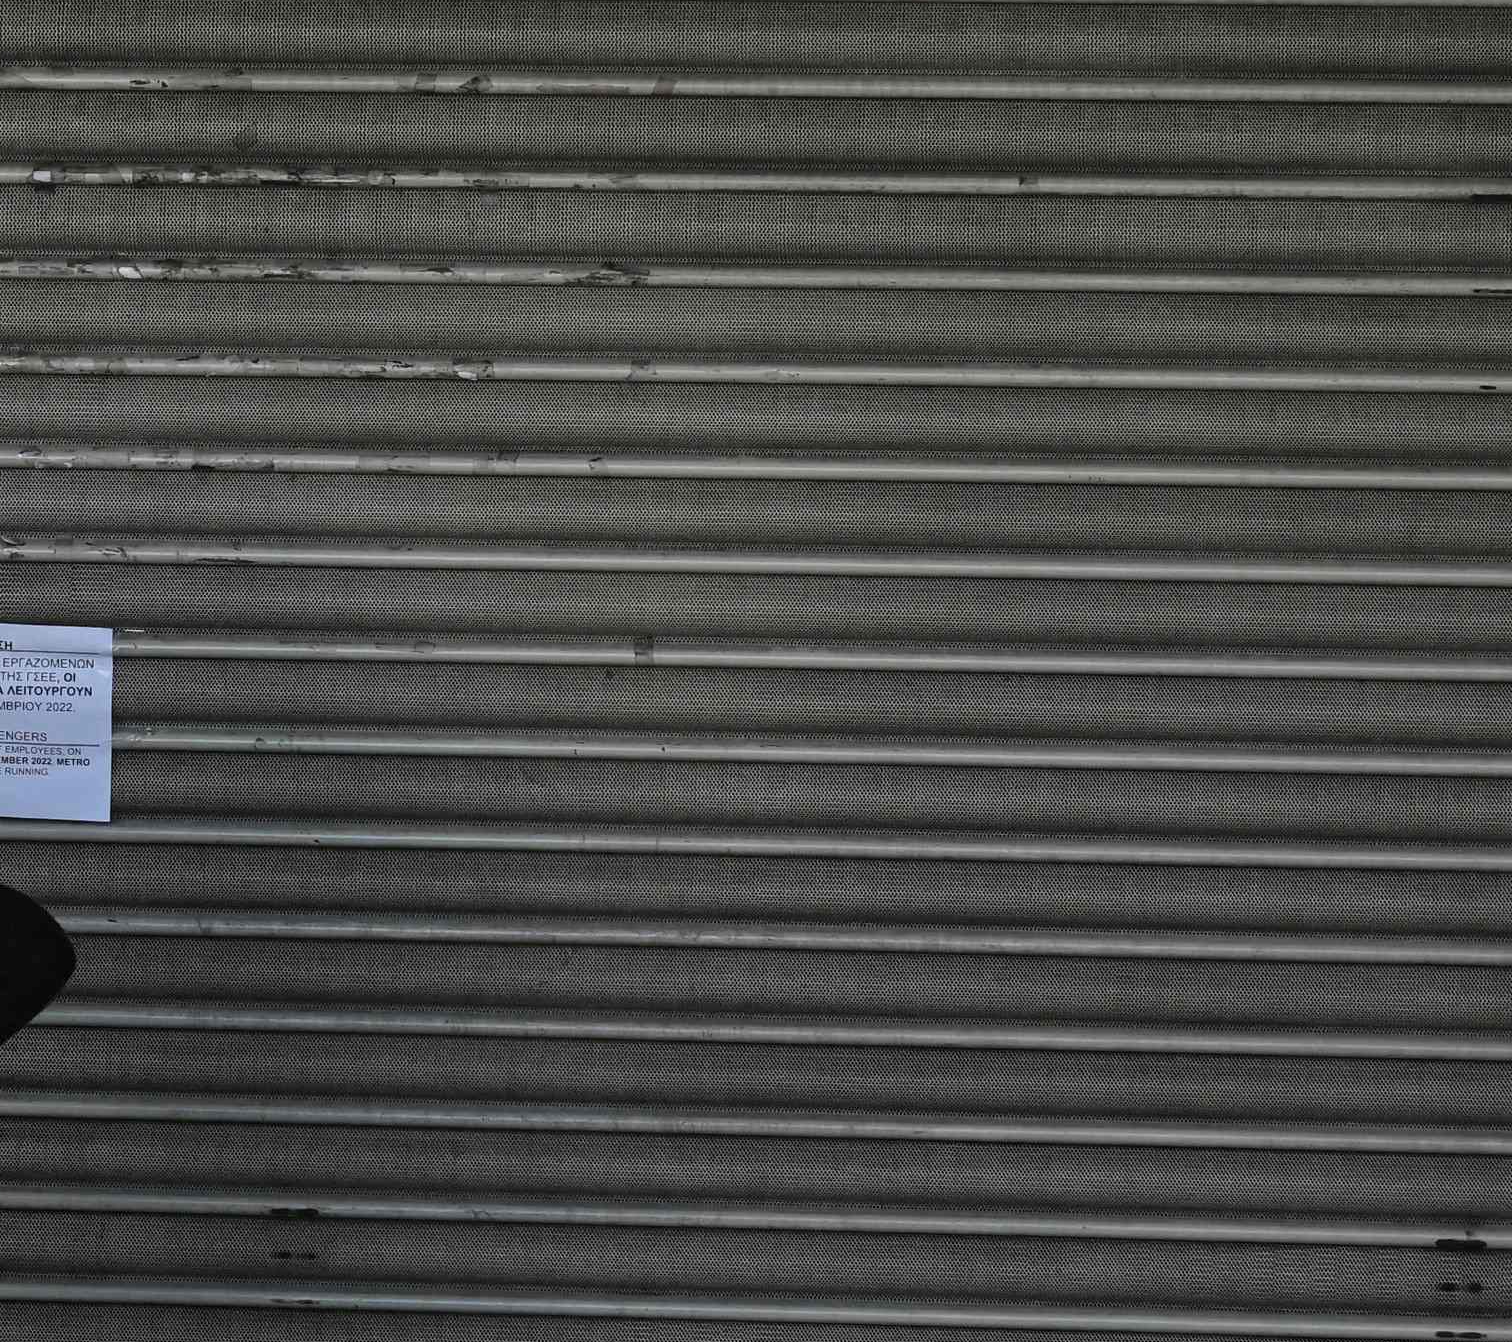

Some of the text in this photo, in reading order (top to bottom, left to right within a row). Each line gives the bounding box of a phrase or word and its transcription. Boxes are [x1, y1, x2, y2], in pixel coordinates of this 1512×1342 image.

[3, 658, 95, 669] ΕΡΓΑΖΟΜΕΝΩΝ
[1, 671, 23, 682] ΤΗΣ
[27, 672, 61, 684] ΓΣΕΕ,
[64, 672, 77, 683] ΟΙ
[7, 686, 93, 697] ΛΕΙΤΟΥΡΓΟΥΝ
[67, 748, 82, 756] ON
[57, 758, 90, 767] METRO
